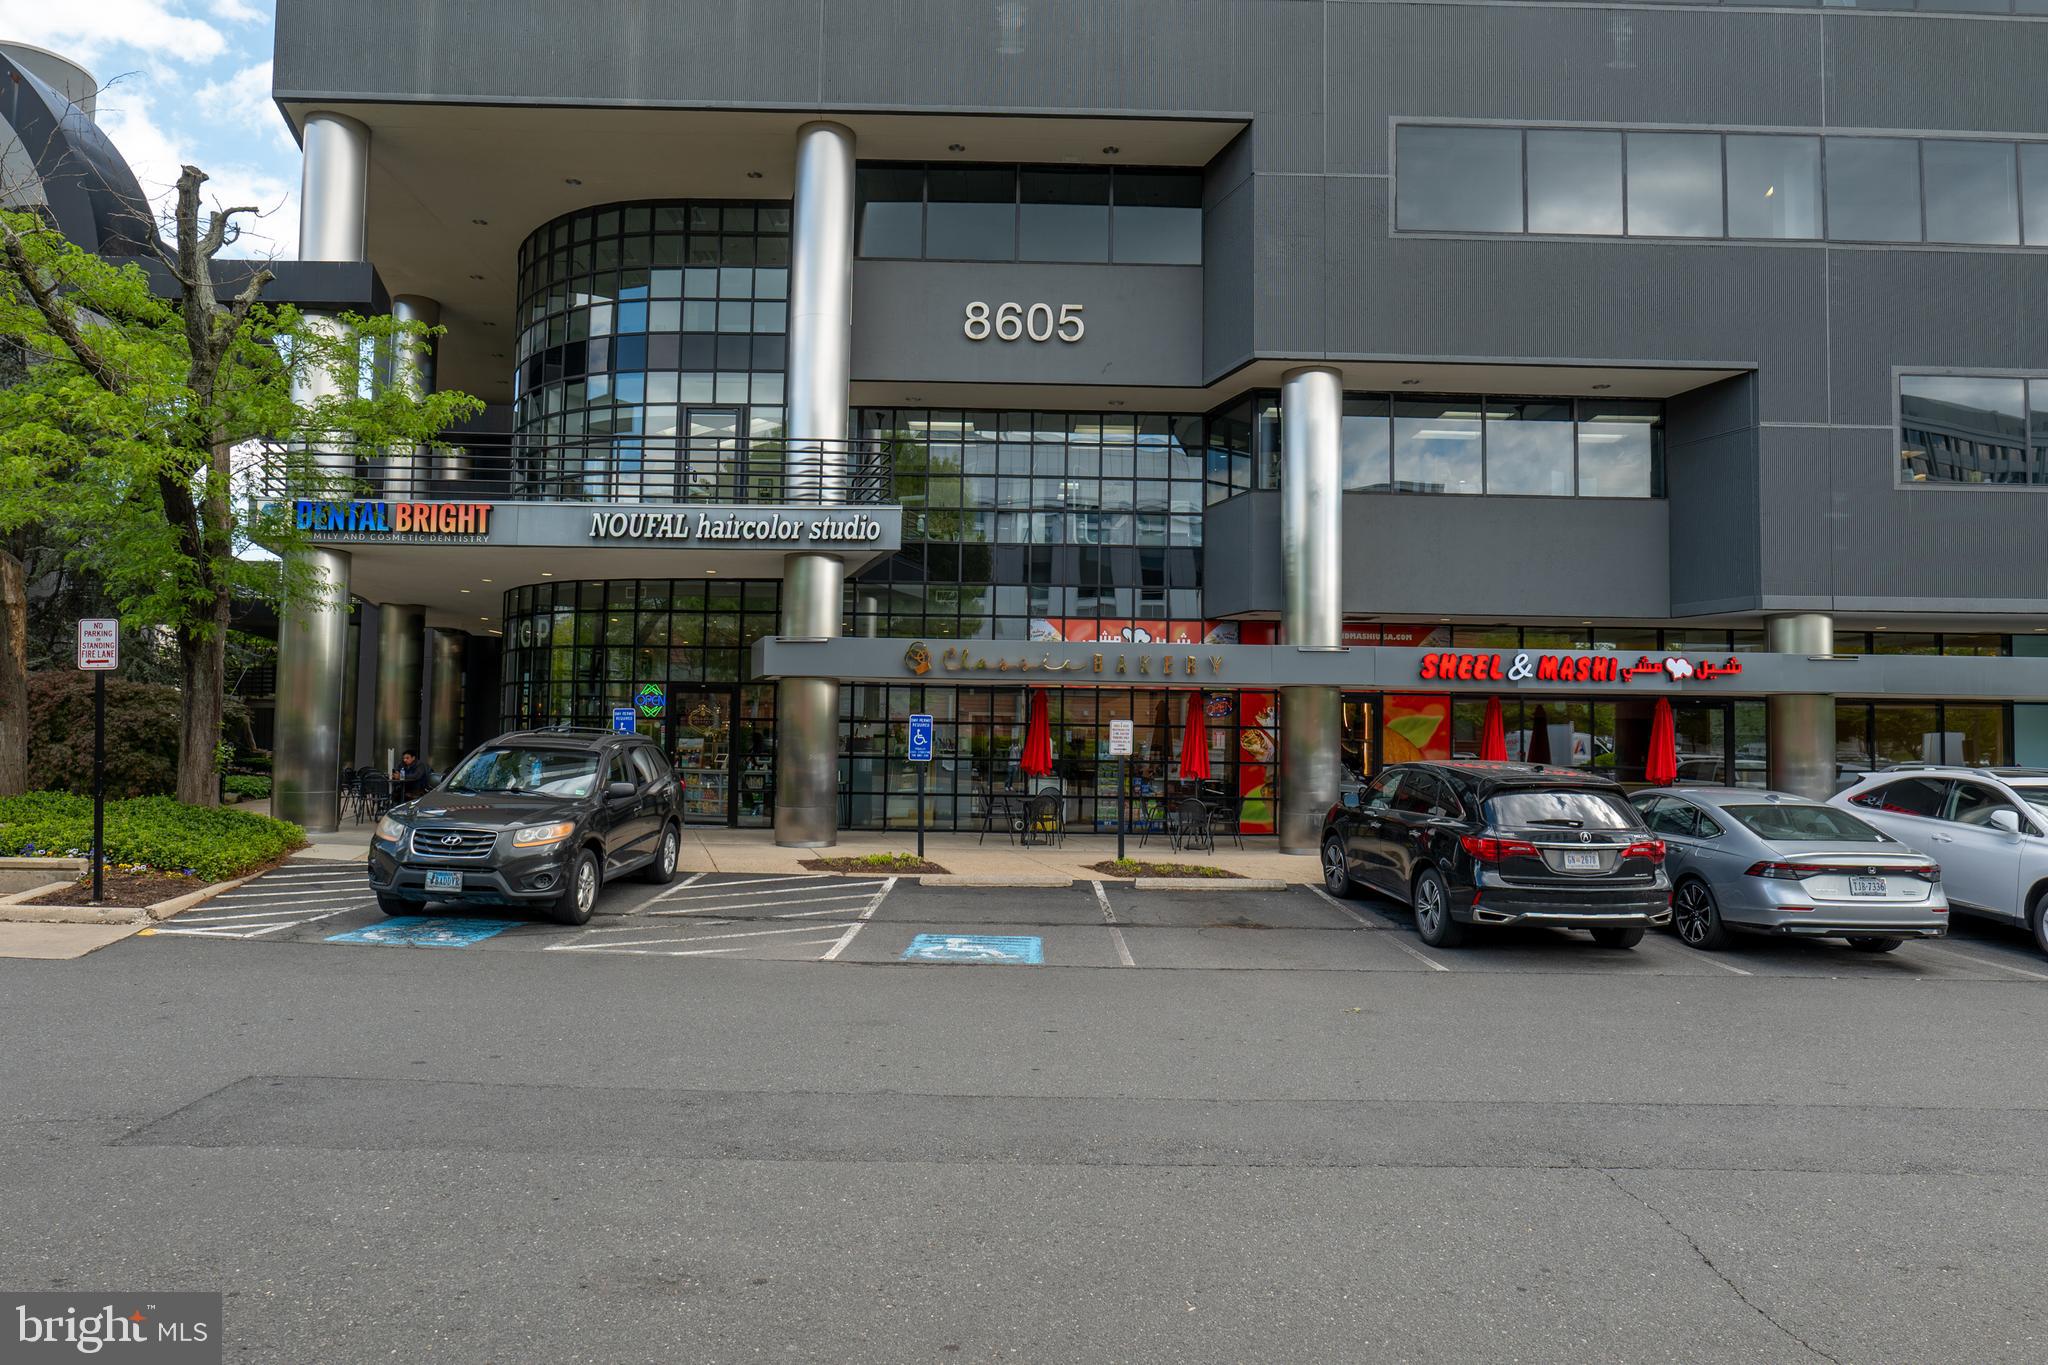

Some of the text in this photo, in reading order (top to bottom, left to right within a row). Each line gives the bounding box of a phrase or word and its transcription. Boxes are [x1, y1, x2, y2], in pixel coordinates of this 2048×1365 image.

[964, 301, 1085, 342] 8605
[296, 502, 492, 534] DENTAL BRIGHT
[589, 512, 881, 541] NOUFAL haircolor studio
[343, 533, 366, 541] AND
[370, 533, 425, 542] COSMETIC
[429, 534, 489, 543] DENTISTRY
[1341, 632, 1413, 641] DMASHIUSA.COM
[82, 650, 115, 658] FIRE LANE
[1093, 652, 1225, 674] BAKERY
[1420, 653, 1618, 682] SHEEL & MASHI
[634, 695, 666, 706] OPEN
